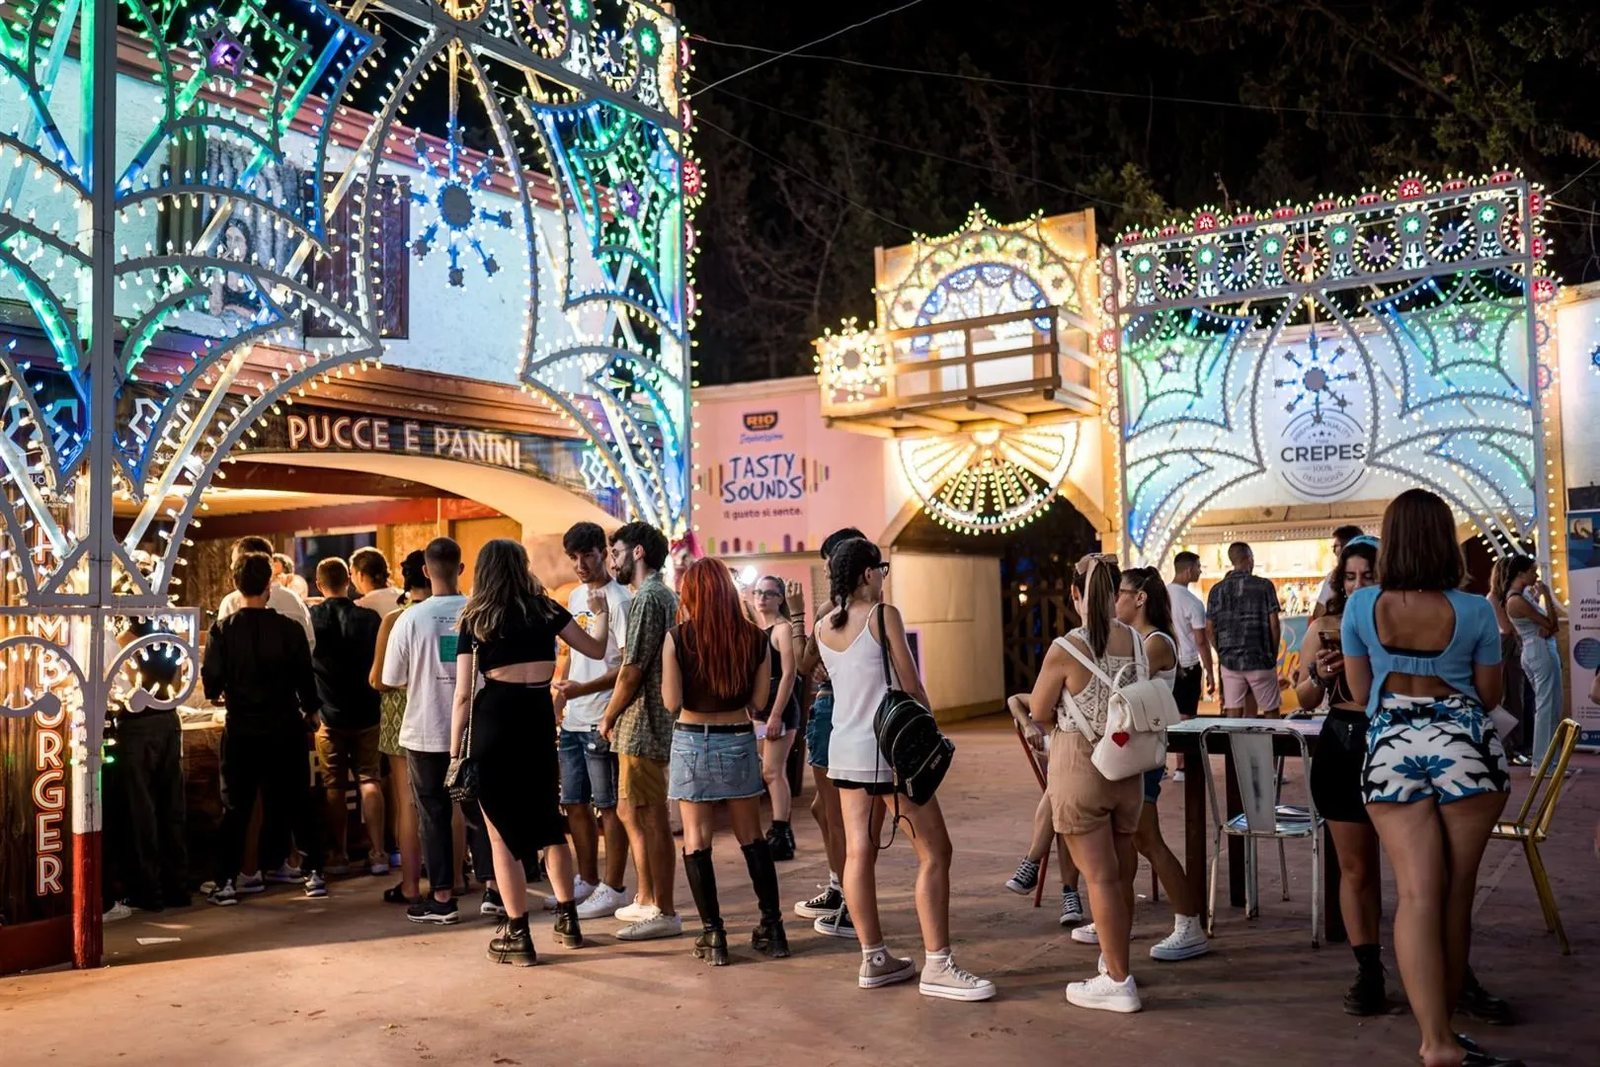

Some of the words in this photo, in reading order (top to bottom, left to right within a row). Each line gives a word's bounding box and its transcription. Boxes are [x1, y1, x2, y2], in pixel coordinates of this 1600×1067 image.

[287, 415, 391, 450] PUCCE
[404, 421, 420, 451] E
[434, 426, 521, 469] PANINI
[1281, 443, 1366, 462] CREPES
[729, 453, 795, 480] TASTY
[724, 476, 803, 503] SOUNDS
[732, 511, 760, 520] gusto
